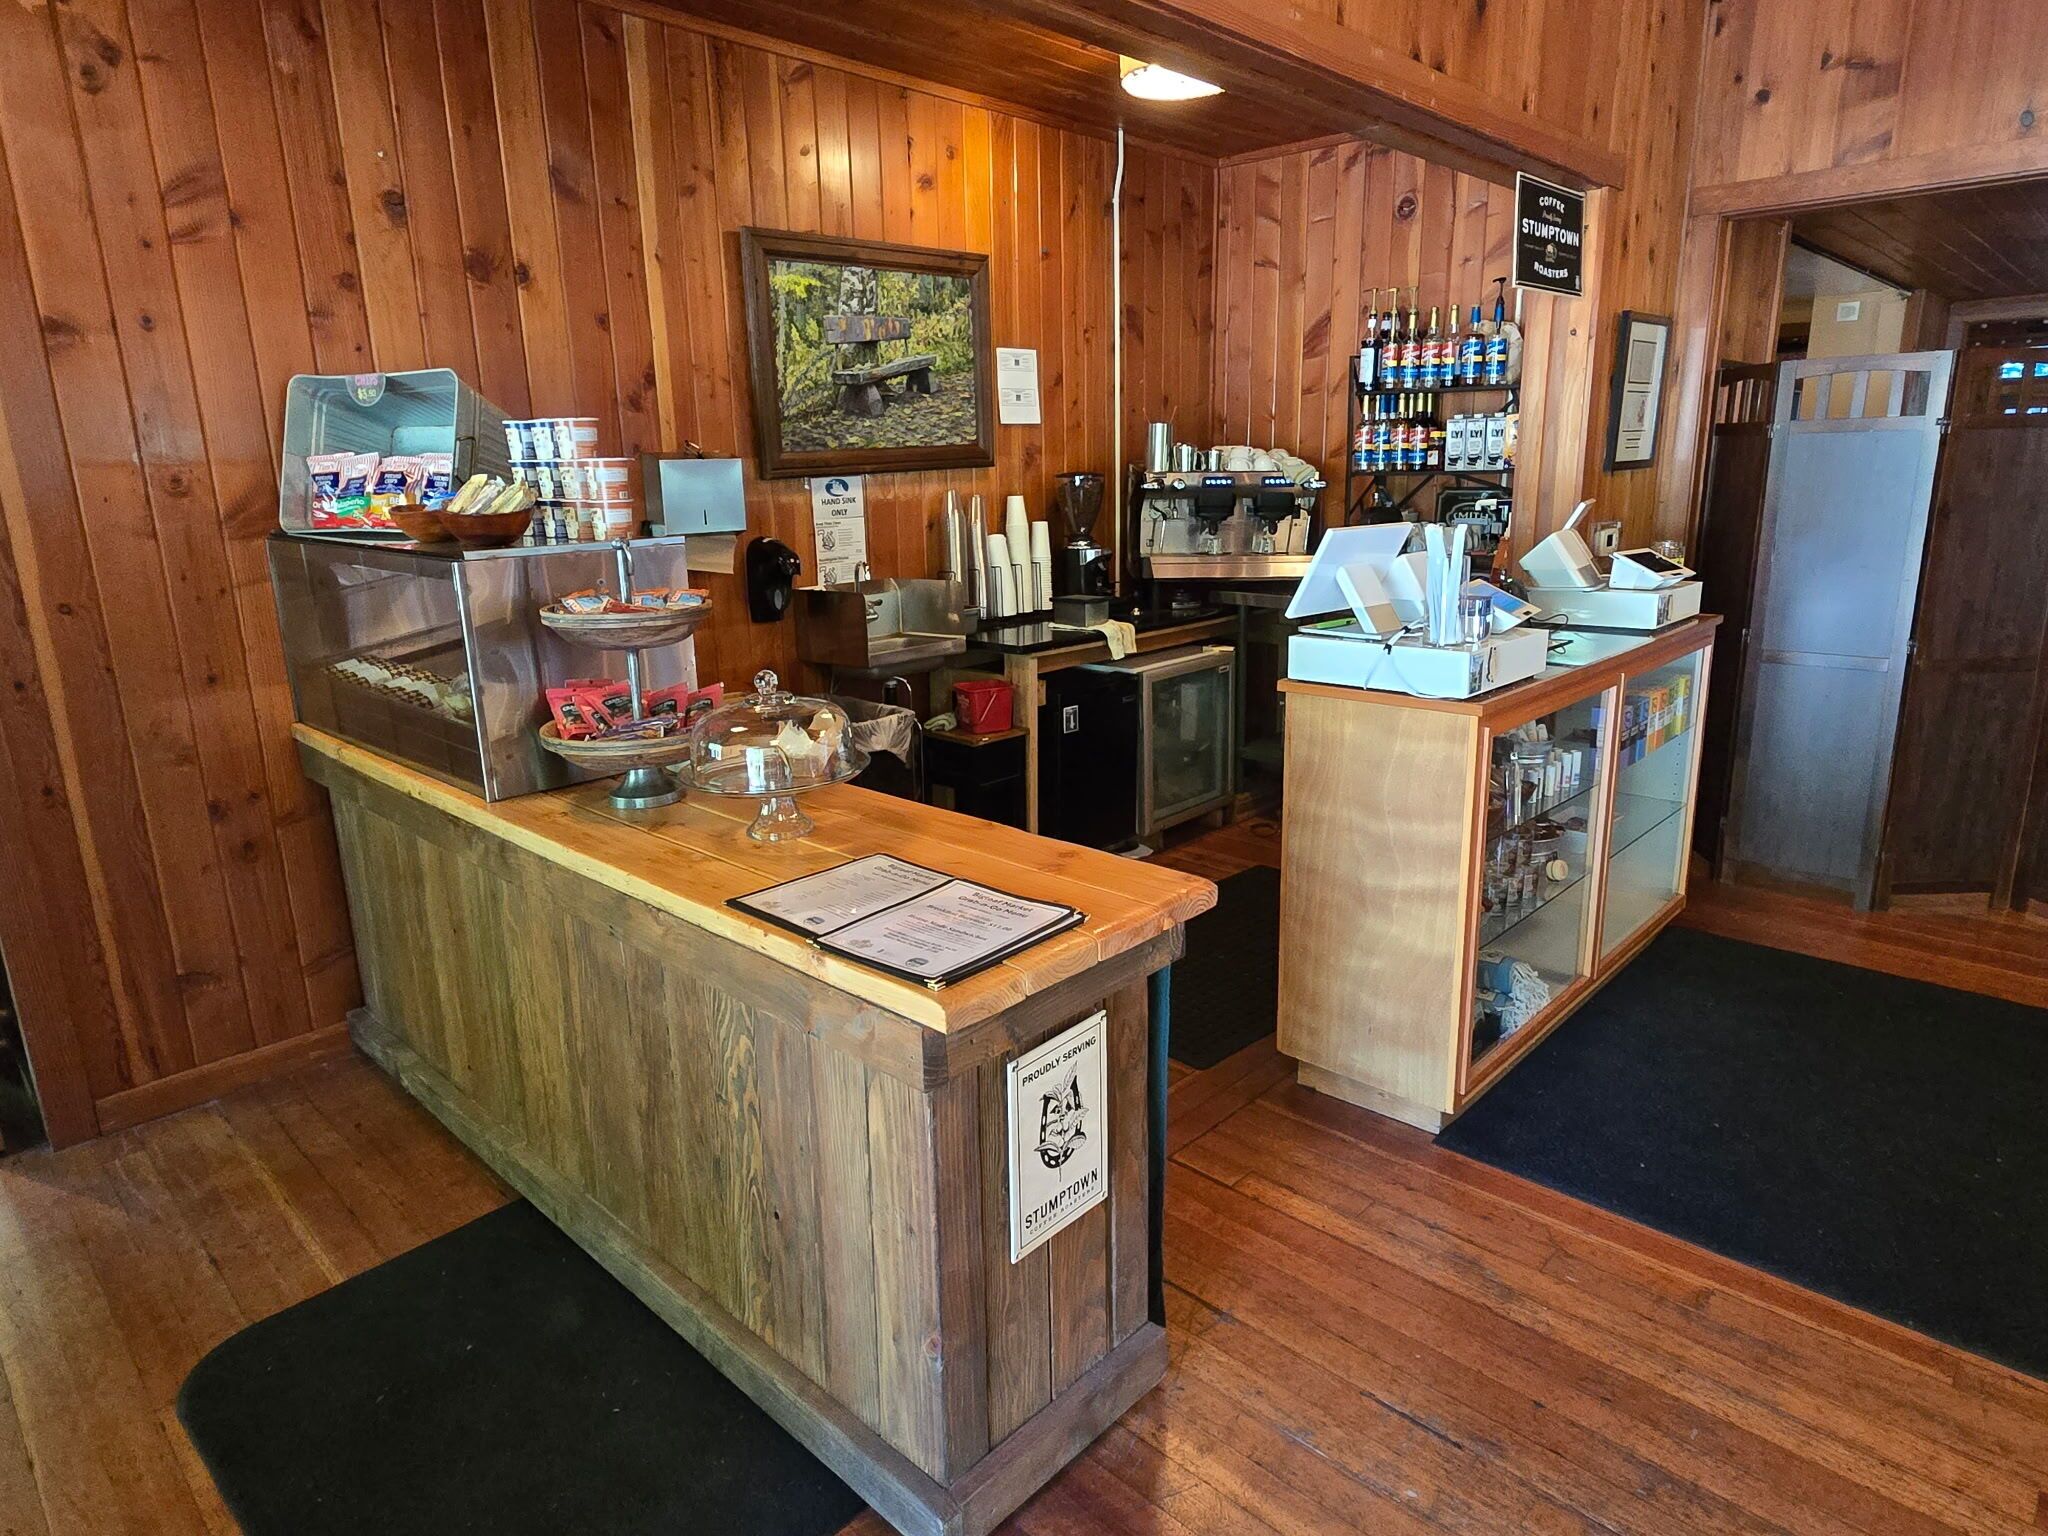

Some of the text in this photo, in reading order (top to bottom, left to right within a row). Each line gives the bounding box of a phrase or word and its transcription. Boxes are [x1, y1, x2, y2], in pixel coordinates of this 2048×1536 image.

[1539, 196, 1565, 213] COFFEE
[1522, 218, 1580, 247] STUMPTOWN
[1534, 261, 1568, 279] ROASTERS
[821, 496, 857, 506] HAND SINK
[831, 509, 848, 517] ONLY
[1022, 1035, 1097, 1087] PROUDLY SERVING
[1025, 1167, 1098, 1229] STUMPTOWN
[1030, 1185, 1095, 1235] COFFEE ROASTERS
